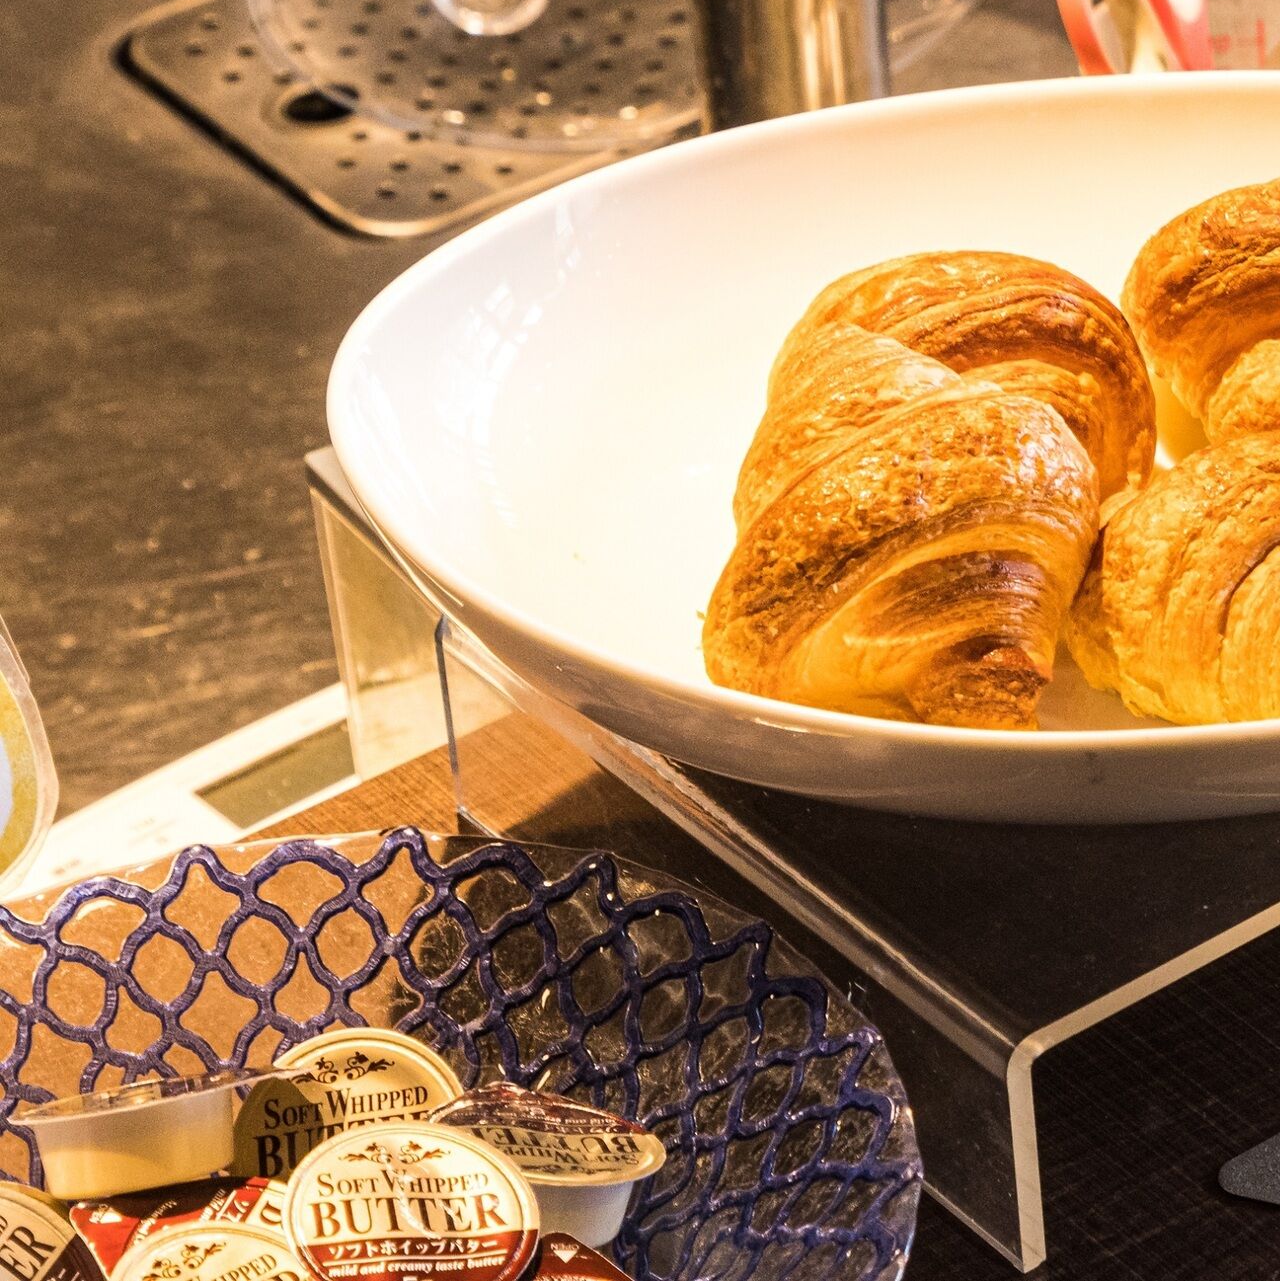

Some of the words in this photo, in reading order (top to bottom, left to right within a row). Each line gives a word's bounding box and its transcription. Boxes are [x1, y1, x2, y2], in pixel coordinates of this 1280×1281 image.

[264, 1098, 323, 1130] SOFT
[325, 1085, 428, 1119] WHIPPED
[316, 1173, 379, 1197] SOFT
[381, 1169, 490, 1195] WHIPPED
[307, 1192, 509, 1239] BUTTER
[328, 1264, 358, 1278] mild
[360, 1262, 385, 1276] and
[387, 1260, 433, 1274] creamy
[435, 1260, 464, 1272] taste
[467, 1255, 505, 1269] butter
